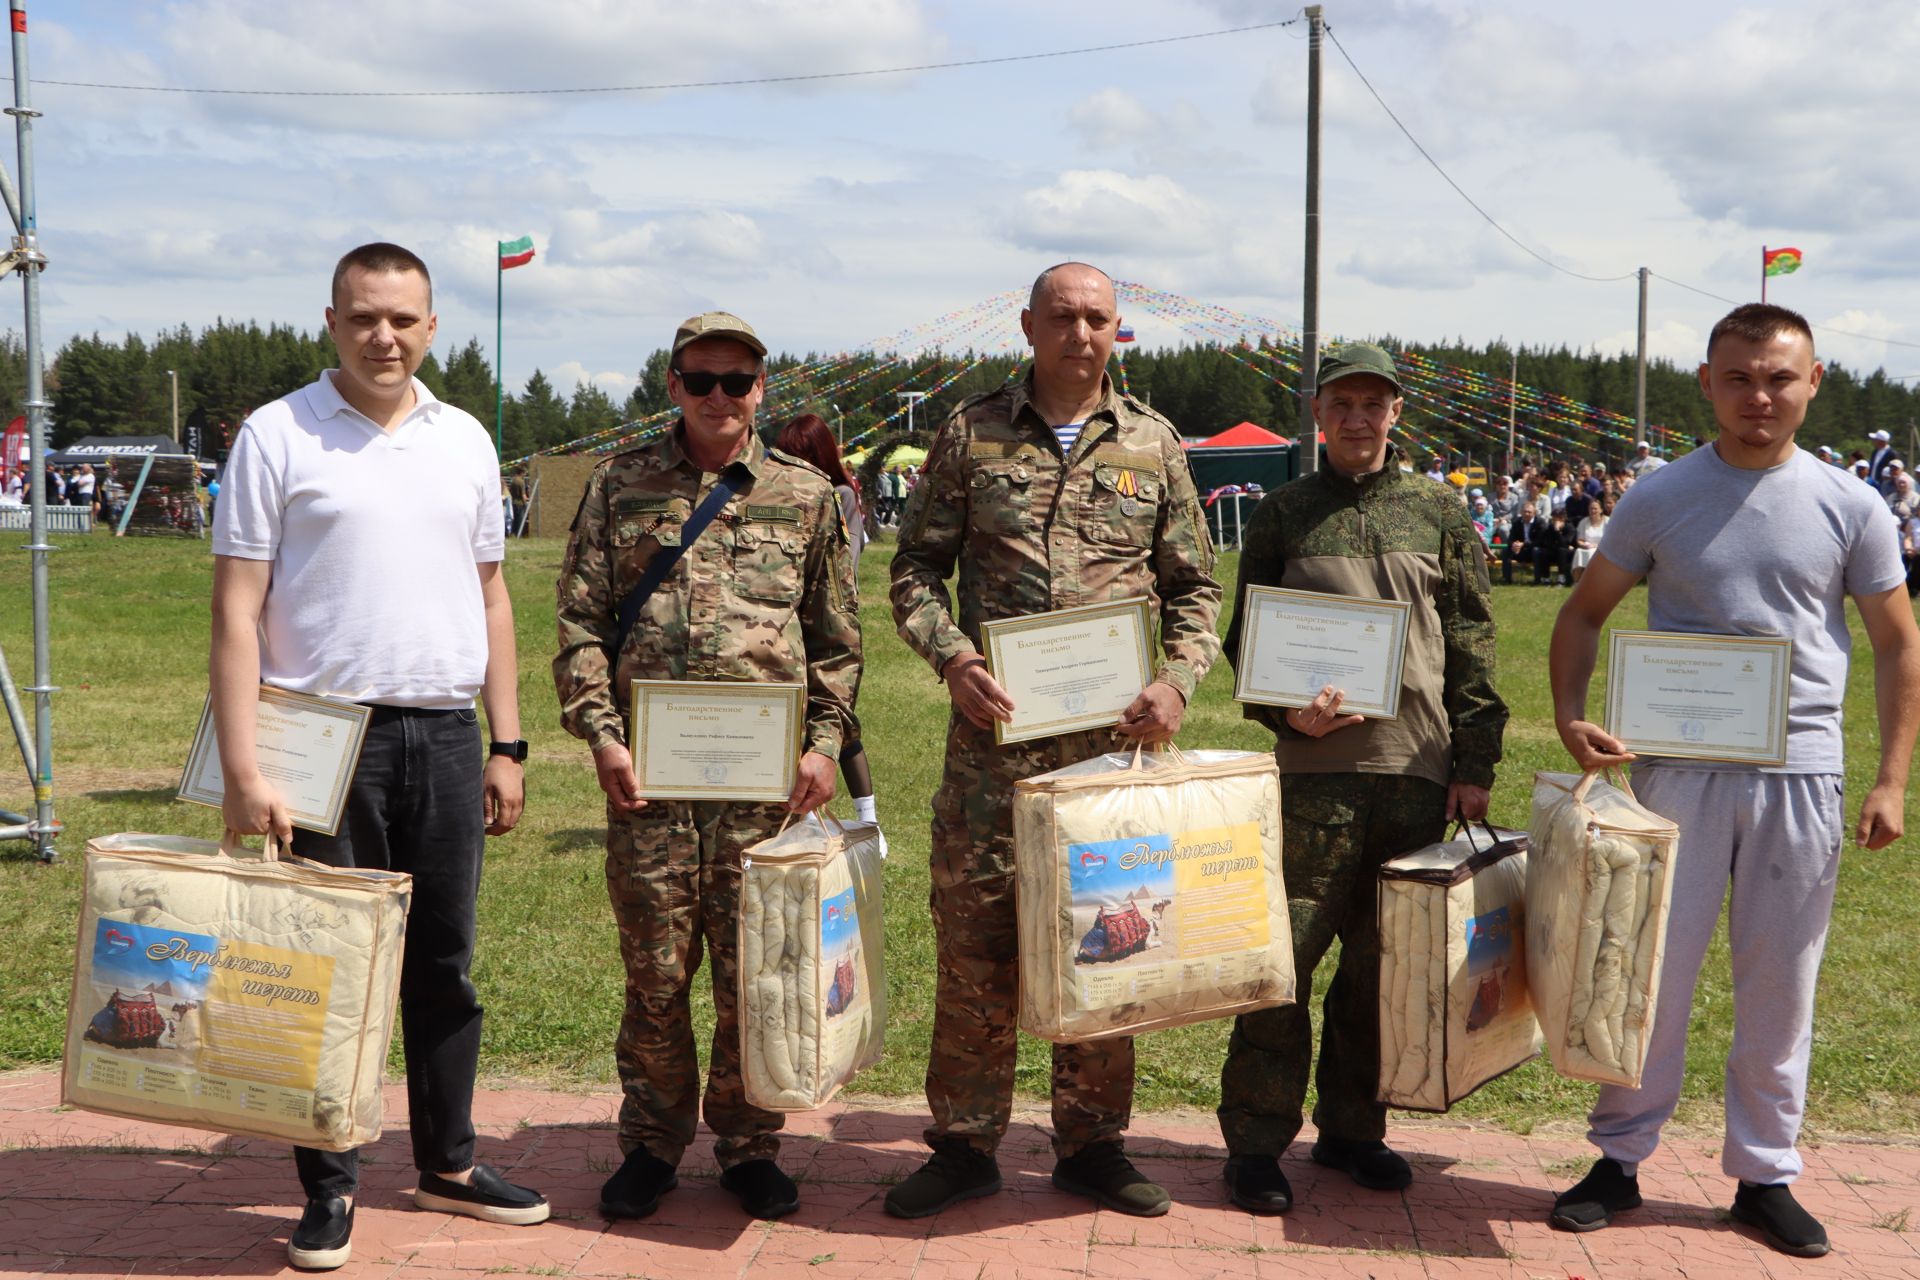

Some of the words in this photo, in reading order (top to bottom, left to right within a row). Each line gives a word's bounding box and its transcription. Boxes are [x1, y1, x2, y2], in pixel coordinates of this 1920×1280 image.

[66, 444, 158, 454] КАПИТАН
[1275, 610, 1350, 627] Благодарственное
[1296, 623, 1326, 633] письмо
[1017, 631, 1092, 650] Благодарственное
[1041, 644, 1071, 655] письмо
[1642, 654, 1724, 668] Благодарственное
[1666, 667, 1699, 675] письмо
[666, 702, 743, 714] Благодарственное
[1119, 839, 1233, 871] Верблюжья
[1201, 856, 1258, 881] шерсть
[146, 937, 291, 978] Верблюжья
[241, 979, 319, 1006] шерсть
